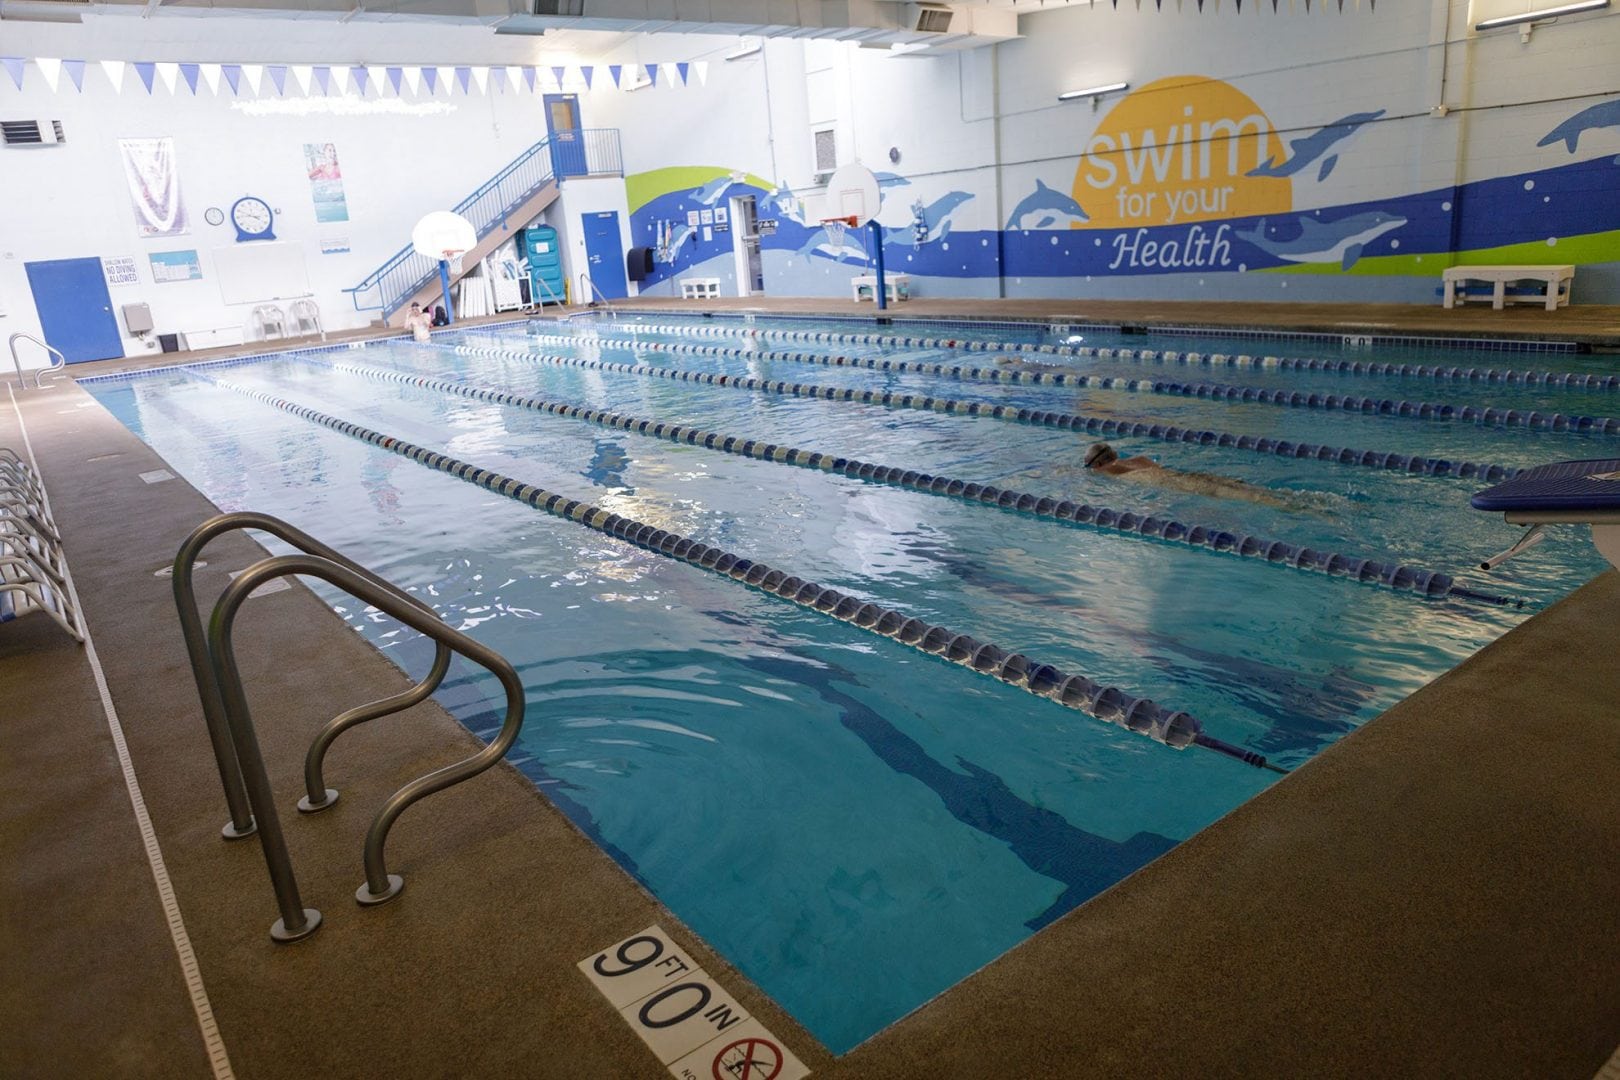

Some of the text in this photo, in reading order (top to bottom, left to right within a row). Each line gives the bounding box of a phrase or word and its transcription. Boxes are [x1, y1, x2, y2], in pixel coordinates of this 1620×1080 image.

[1085, 106, 1269, 189] swim
[1115, 186, 1234, 224] for your
[1109, 224, 1231, 269] Health
[106, 264, 135, 274] NO DIVING
[110, 273, 137, 283] ALLOWED
[593, 936, 689, 977] 9 FT
[639, 982, 740, 1031] 0 IN
[681, 1068, 697, 1080] NO
